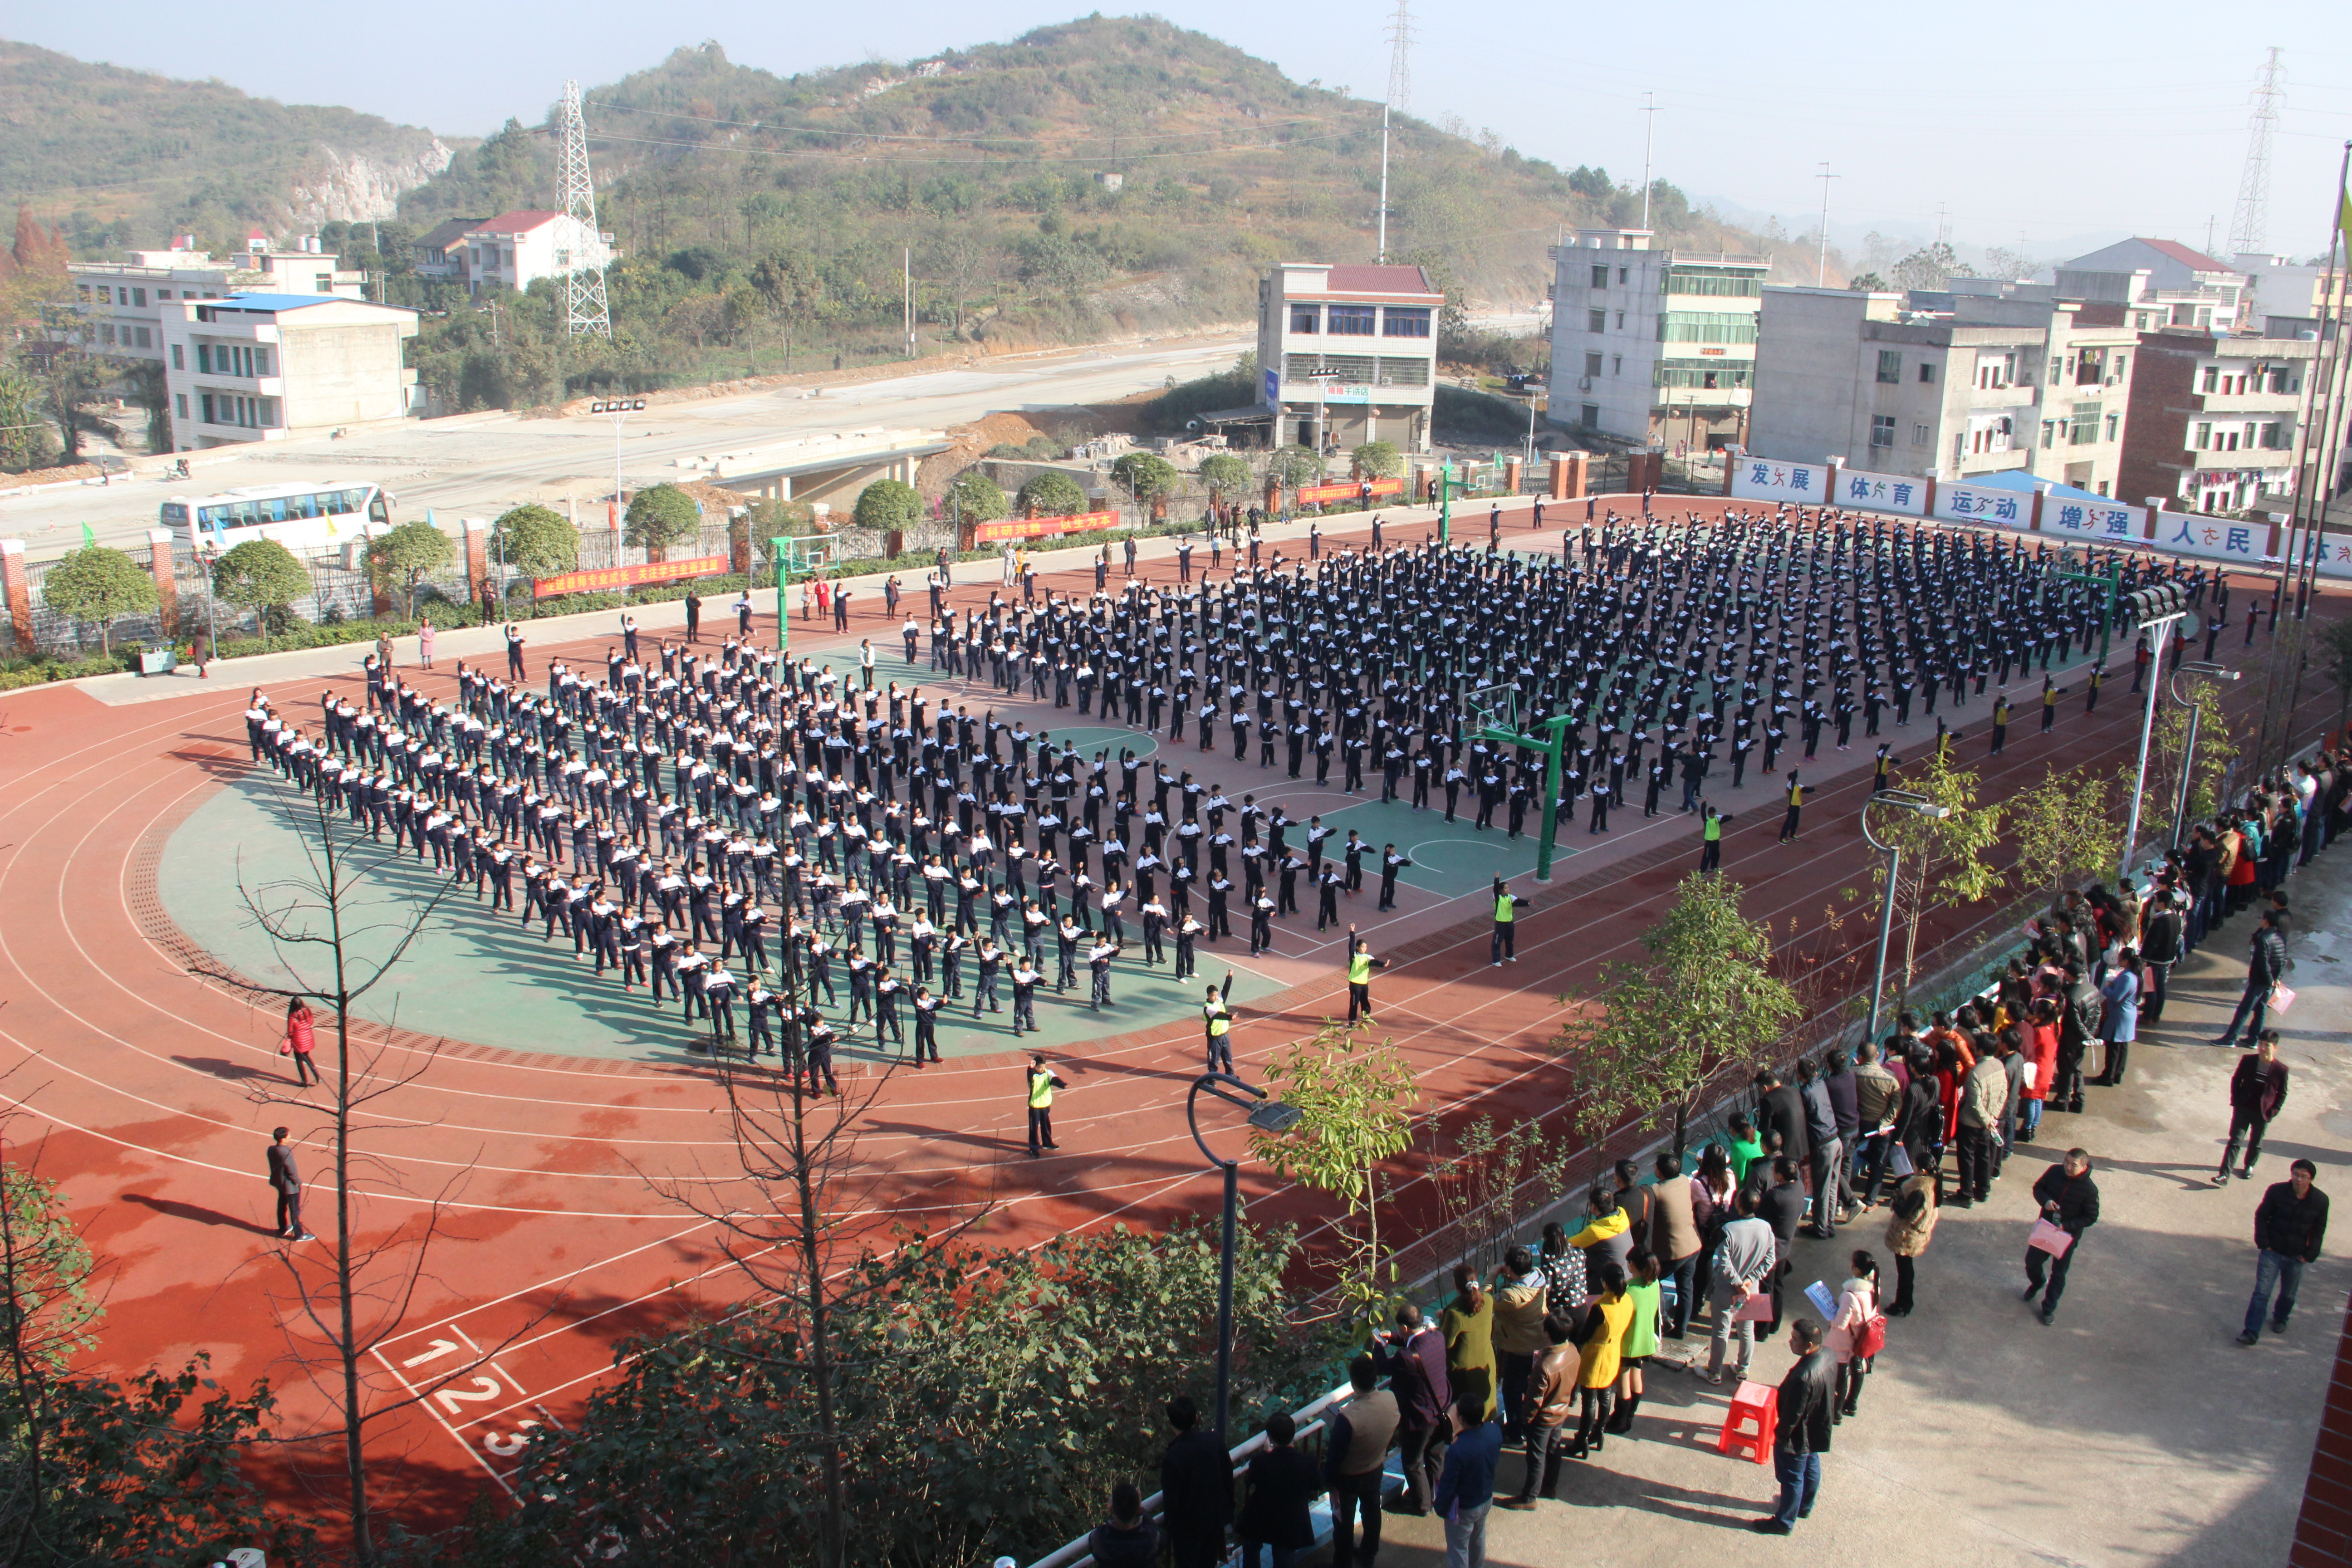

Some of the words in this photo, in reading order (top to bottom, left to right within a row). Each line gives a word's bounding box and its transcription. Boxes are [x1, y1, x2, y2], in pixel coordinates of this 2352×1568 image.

[986, 522, 1041, 538] 科研兴教
[1060, 514, 1111, 530] 以生为本
[1750, 464, 1809, 490] 发展
[1850, 477, 1911, 505] 体育
[1950, 490, 2017, 519] 运动
[2059, 505, 2128, 534] 增强
[2172, 520, 2249, 553] 人民
[545, 570, 629, 592] 促进教师专业成长
[638, 559, 718, 580] 关注学生全面发展
[403, 1339, 459, 1368] 1
[433, 1376, 501, 1415] 2
[484, 1419, 544, 1456] 3
